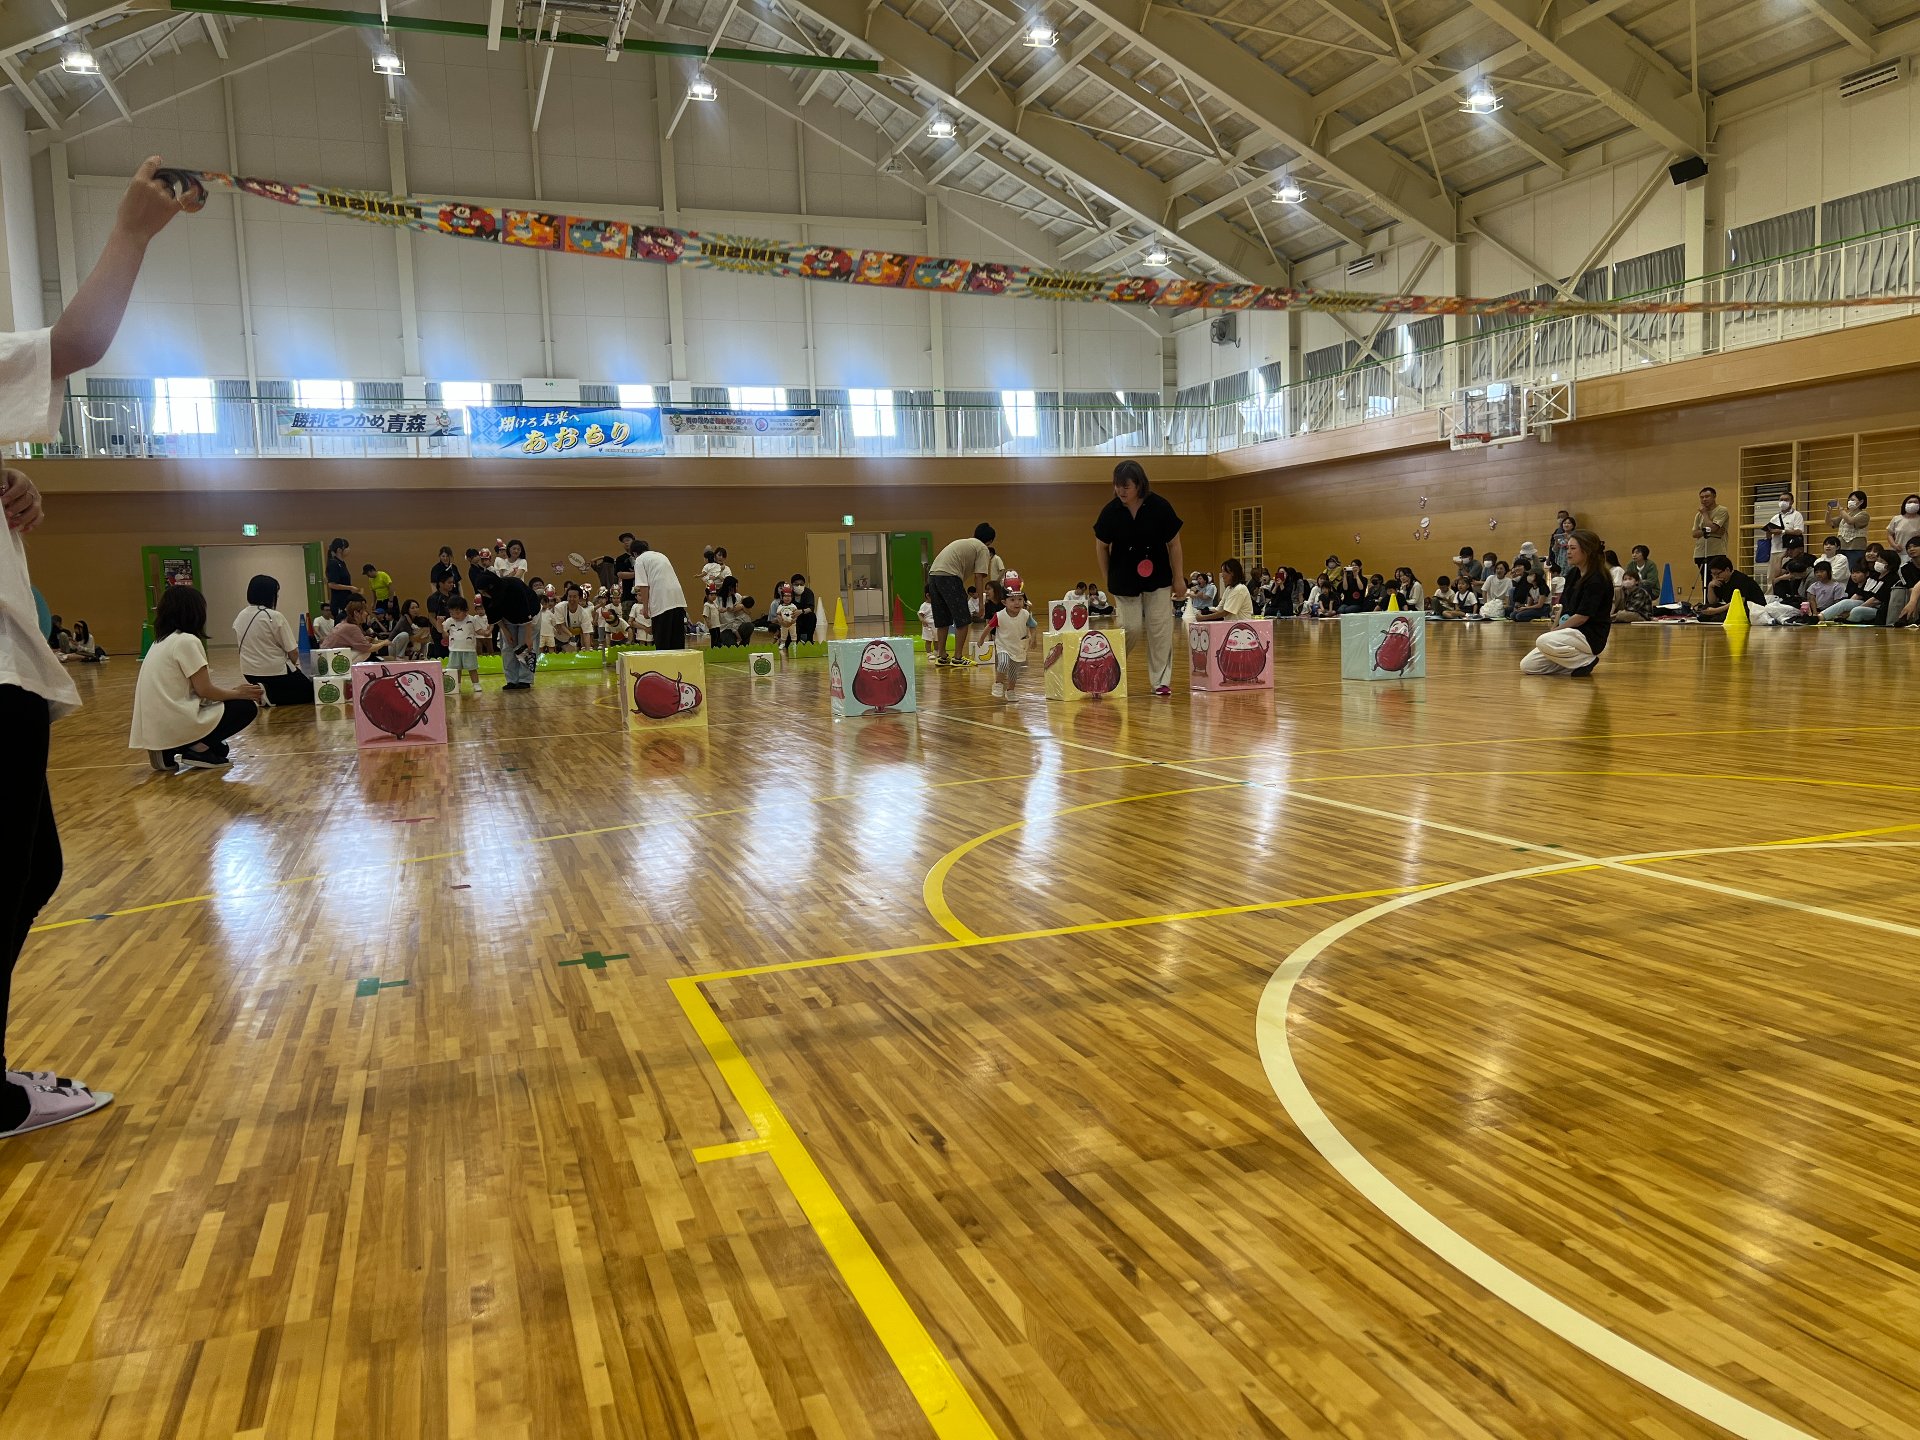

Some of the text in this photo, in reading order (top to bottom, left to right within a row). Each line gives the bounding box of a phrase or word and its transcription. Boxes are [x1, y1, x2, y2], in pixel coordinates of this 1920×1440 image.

[291, 412, 427, 433] 勝利をつかめ青森
[499, 411, 580, 432] 翔けろ未来へ
[522, 422, 631, 454] あおもり
